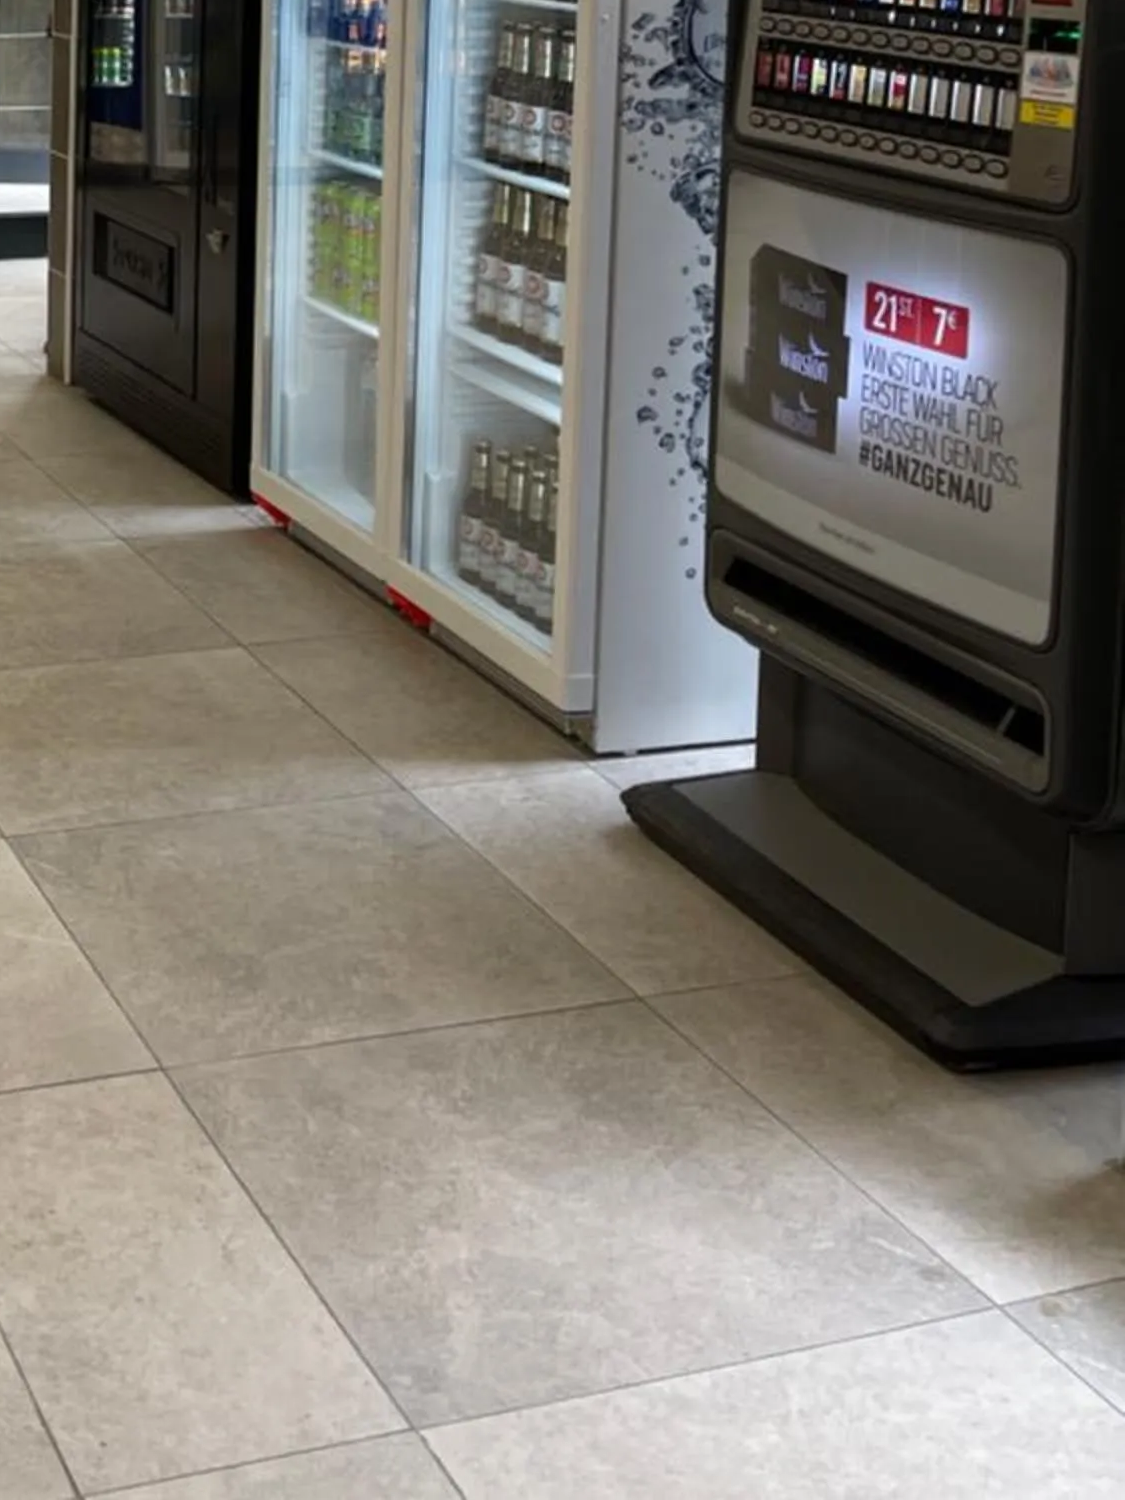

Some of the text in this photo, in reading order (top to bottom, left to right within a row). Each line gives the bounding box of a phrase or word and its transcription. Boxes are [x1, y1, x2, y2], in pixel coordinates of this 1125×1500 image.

[779, 332, 829, 383] Winston
[863, 341, 998, 409] WINSTON BLACK
[861, 374, 909, 417] ERSTE
[913, 392, 961, 435] WAHL
[858, 439, 993, 513] #GANZGENAU
[859, 406, 1022, 490] GROSSEN GENUSS.
